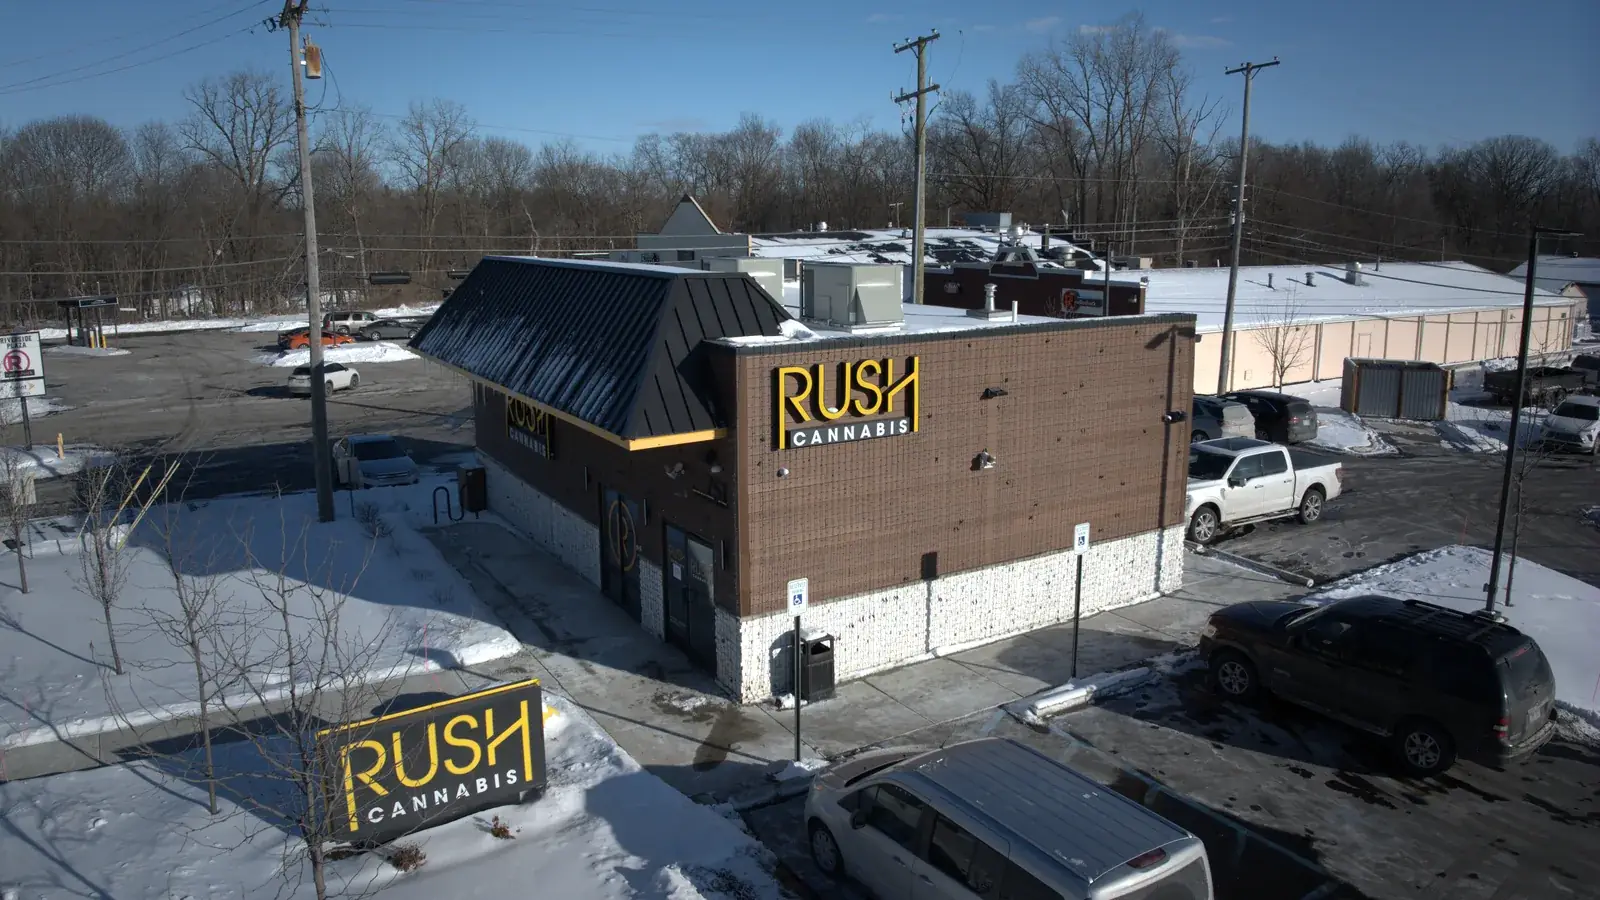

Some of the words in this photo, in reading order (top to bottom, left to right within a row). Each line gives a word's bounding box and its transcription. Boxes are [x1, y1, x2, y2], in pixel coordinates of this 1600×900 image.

[777, 356, 919, 450] RUSH
[509, 427, 546, 458] CANNABIS
[793, 419, 909, 447] CANNABIS
[340, 700, 533, 832] RUSH
[367, 769, 519, 824] CANNABIS
